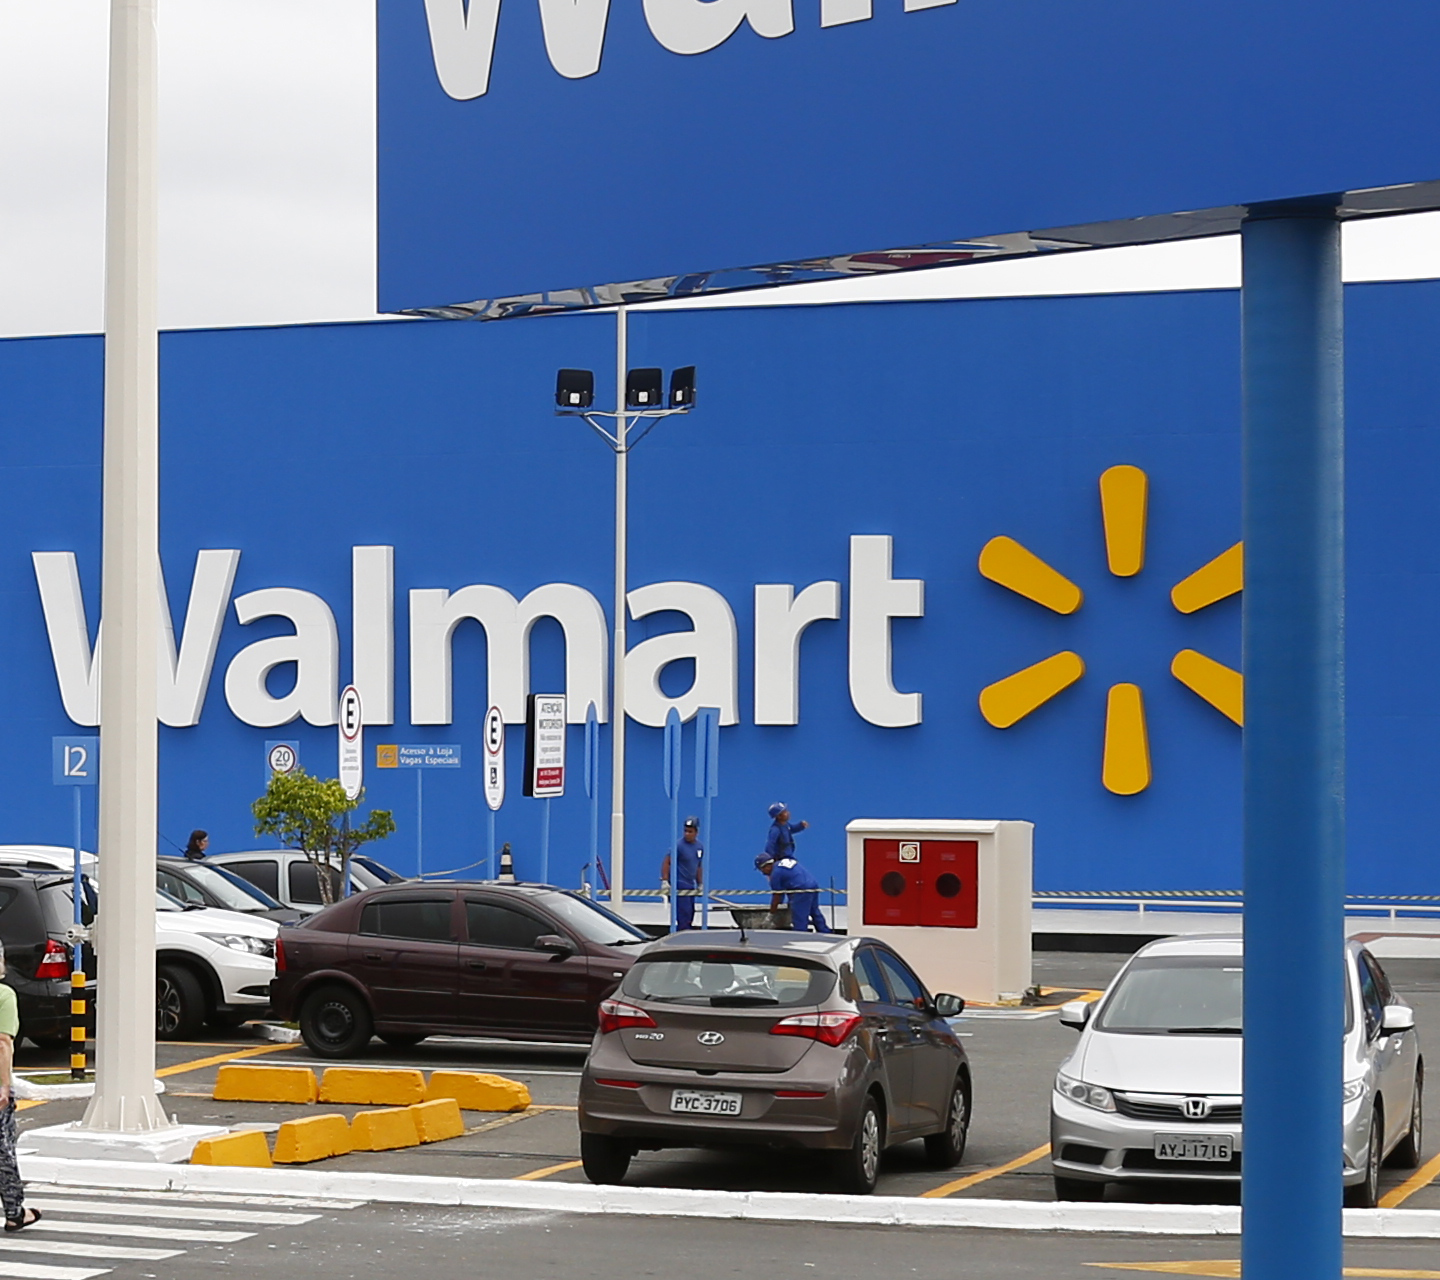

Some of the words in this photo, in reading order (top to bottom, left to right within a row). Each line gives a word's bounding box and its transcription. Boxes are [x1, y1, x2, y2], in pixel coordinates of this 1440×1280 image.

[31, 534, 924, 728] Walmart
[346, 697, 355, 730] E
[490, 715, 498, 745] E
[275, 750, 291, 763] 20
[399, 747, 427, 755] Acesso
[436, 747, 454, 757] Loja
[64, 745, 88, 777] 12
[399, 756, 423, 766] Vagas
[424, 756, 460, 766] Especiais
[674, 1097, 738, 1112] PYC-3706
[1159, 1143, 1228, 1158] AYJ-1716
